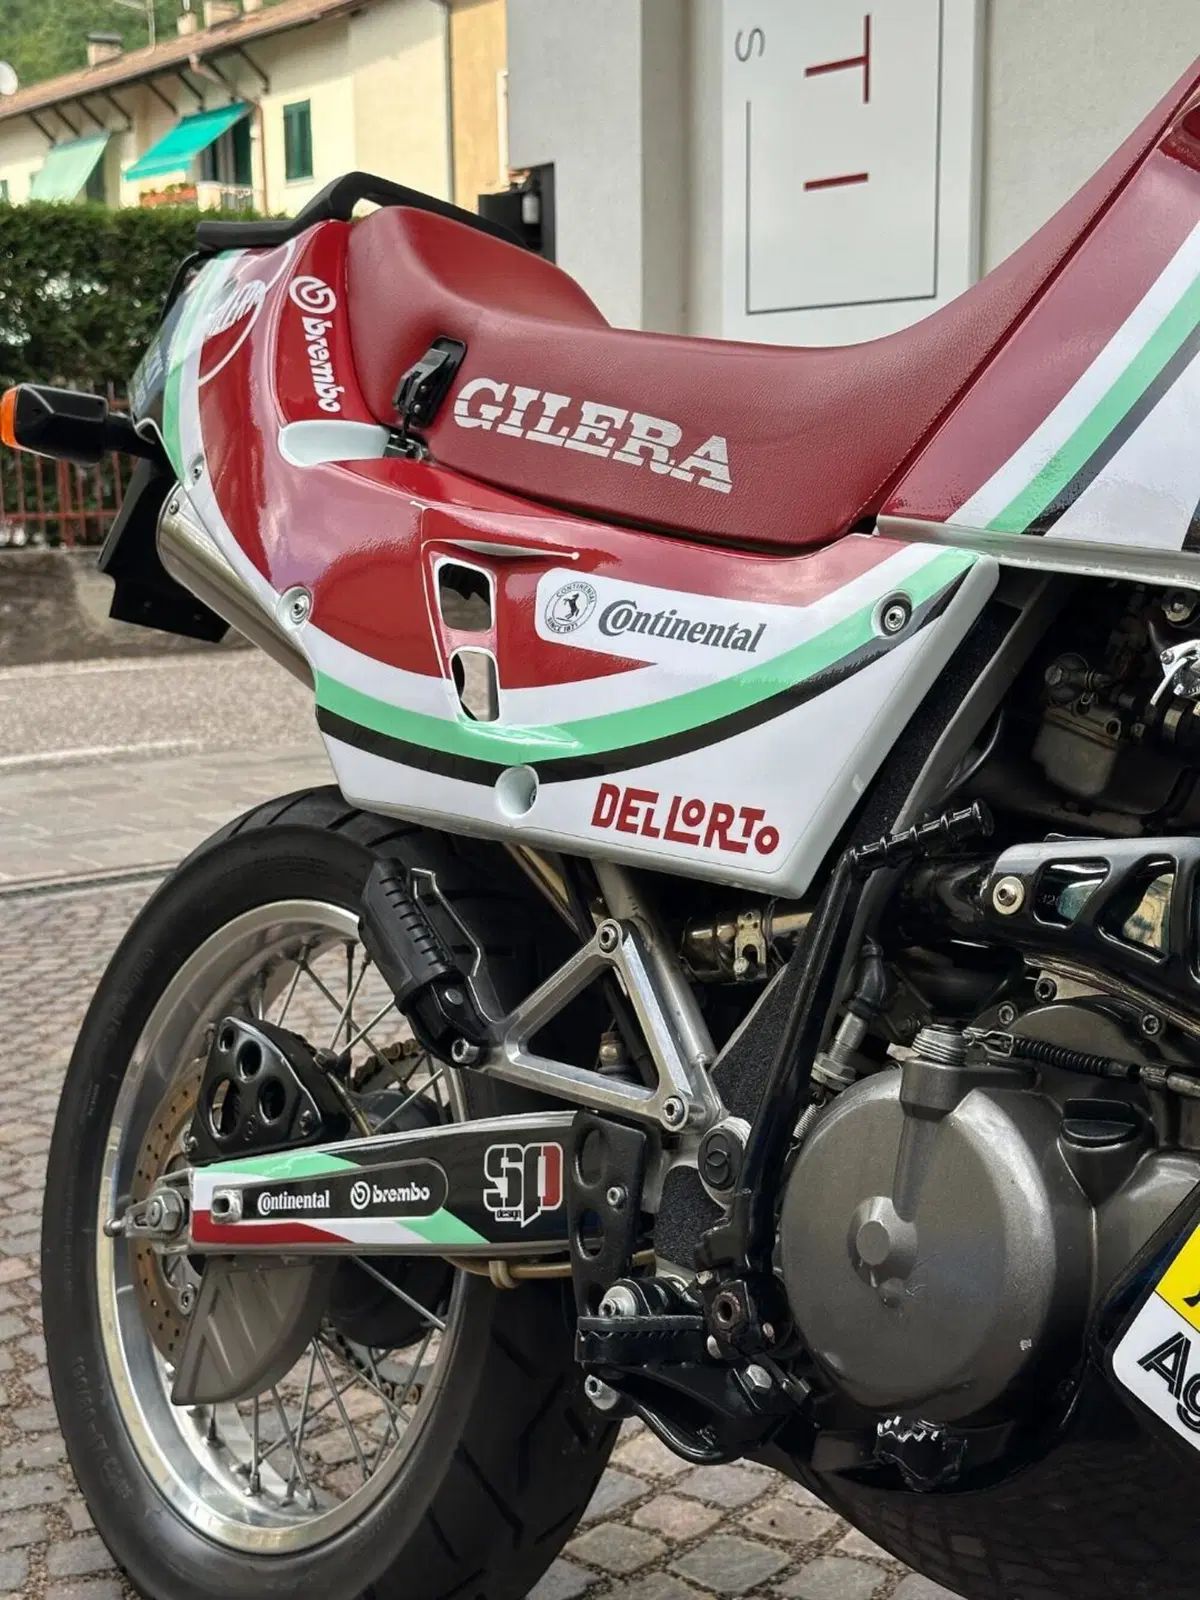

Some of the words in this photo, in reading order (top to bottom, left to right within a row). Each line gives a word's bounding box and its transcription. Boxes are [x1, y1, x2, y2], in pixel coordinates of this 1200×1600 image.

[302, 316, 345, 413] brembo
[453, 377, 733, 494] GILERA
[598, 599, 767, 652] Continental
[590, 782, 780, 856] DELLORTO
[257, 1189, 330, 1216] Continental
[372, 1181, 431, 1203] brembo
